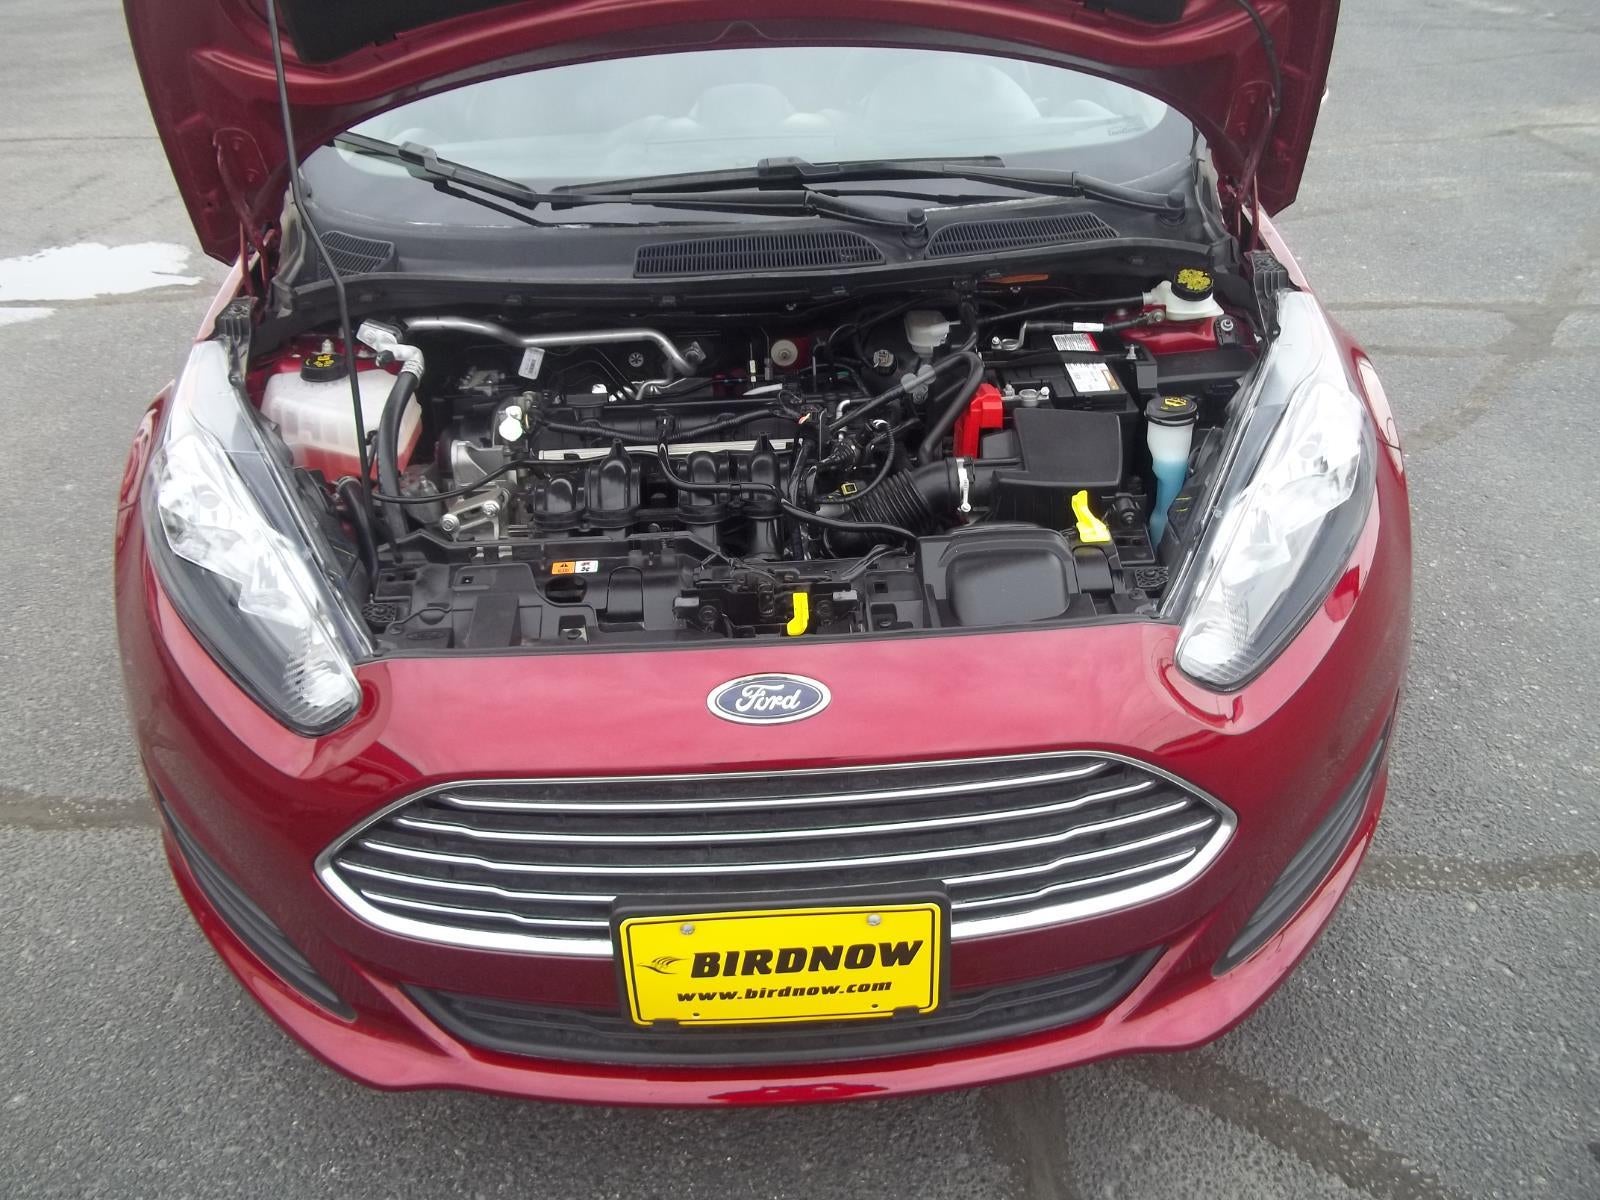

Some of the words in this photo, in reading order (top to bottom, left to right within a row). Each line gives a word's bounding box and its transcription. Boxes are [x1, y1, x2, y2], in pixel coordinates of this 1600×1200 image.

[735, 684, 801, 711] Ford
[690, 940, 924, 979] BIRDNOW
[676, 981, 893, 1002] www.birdnow.com
